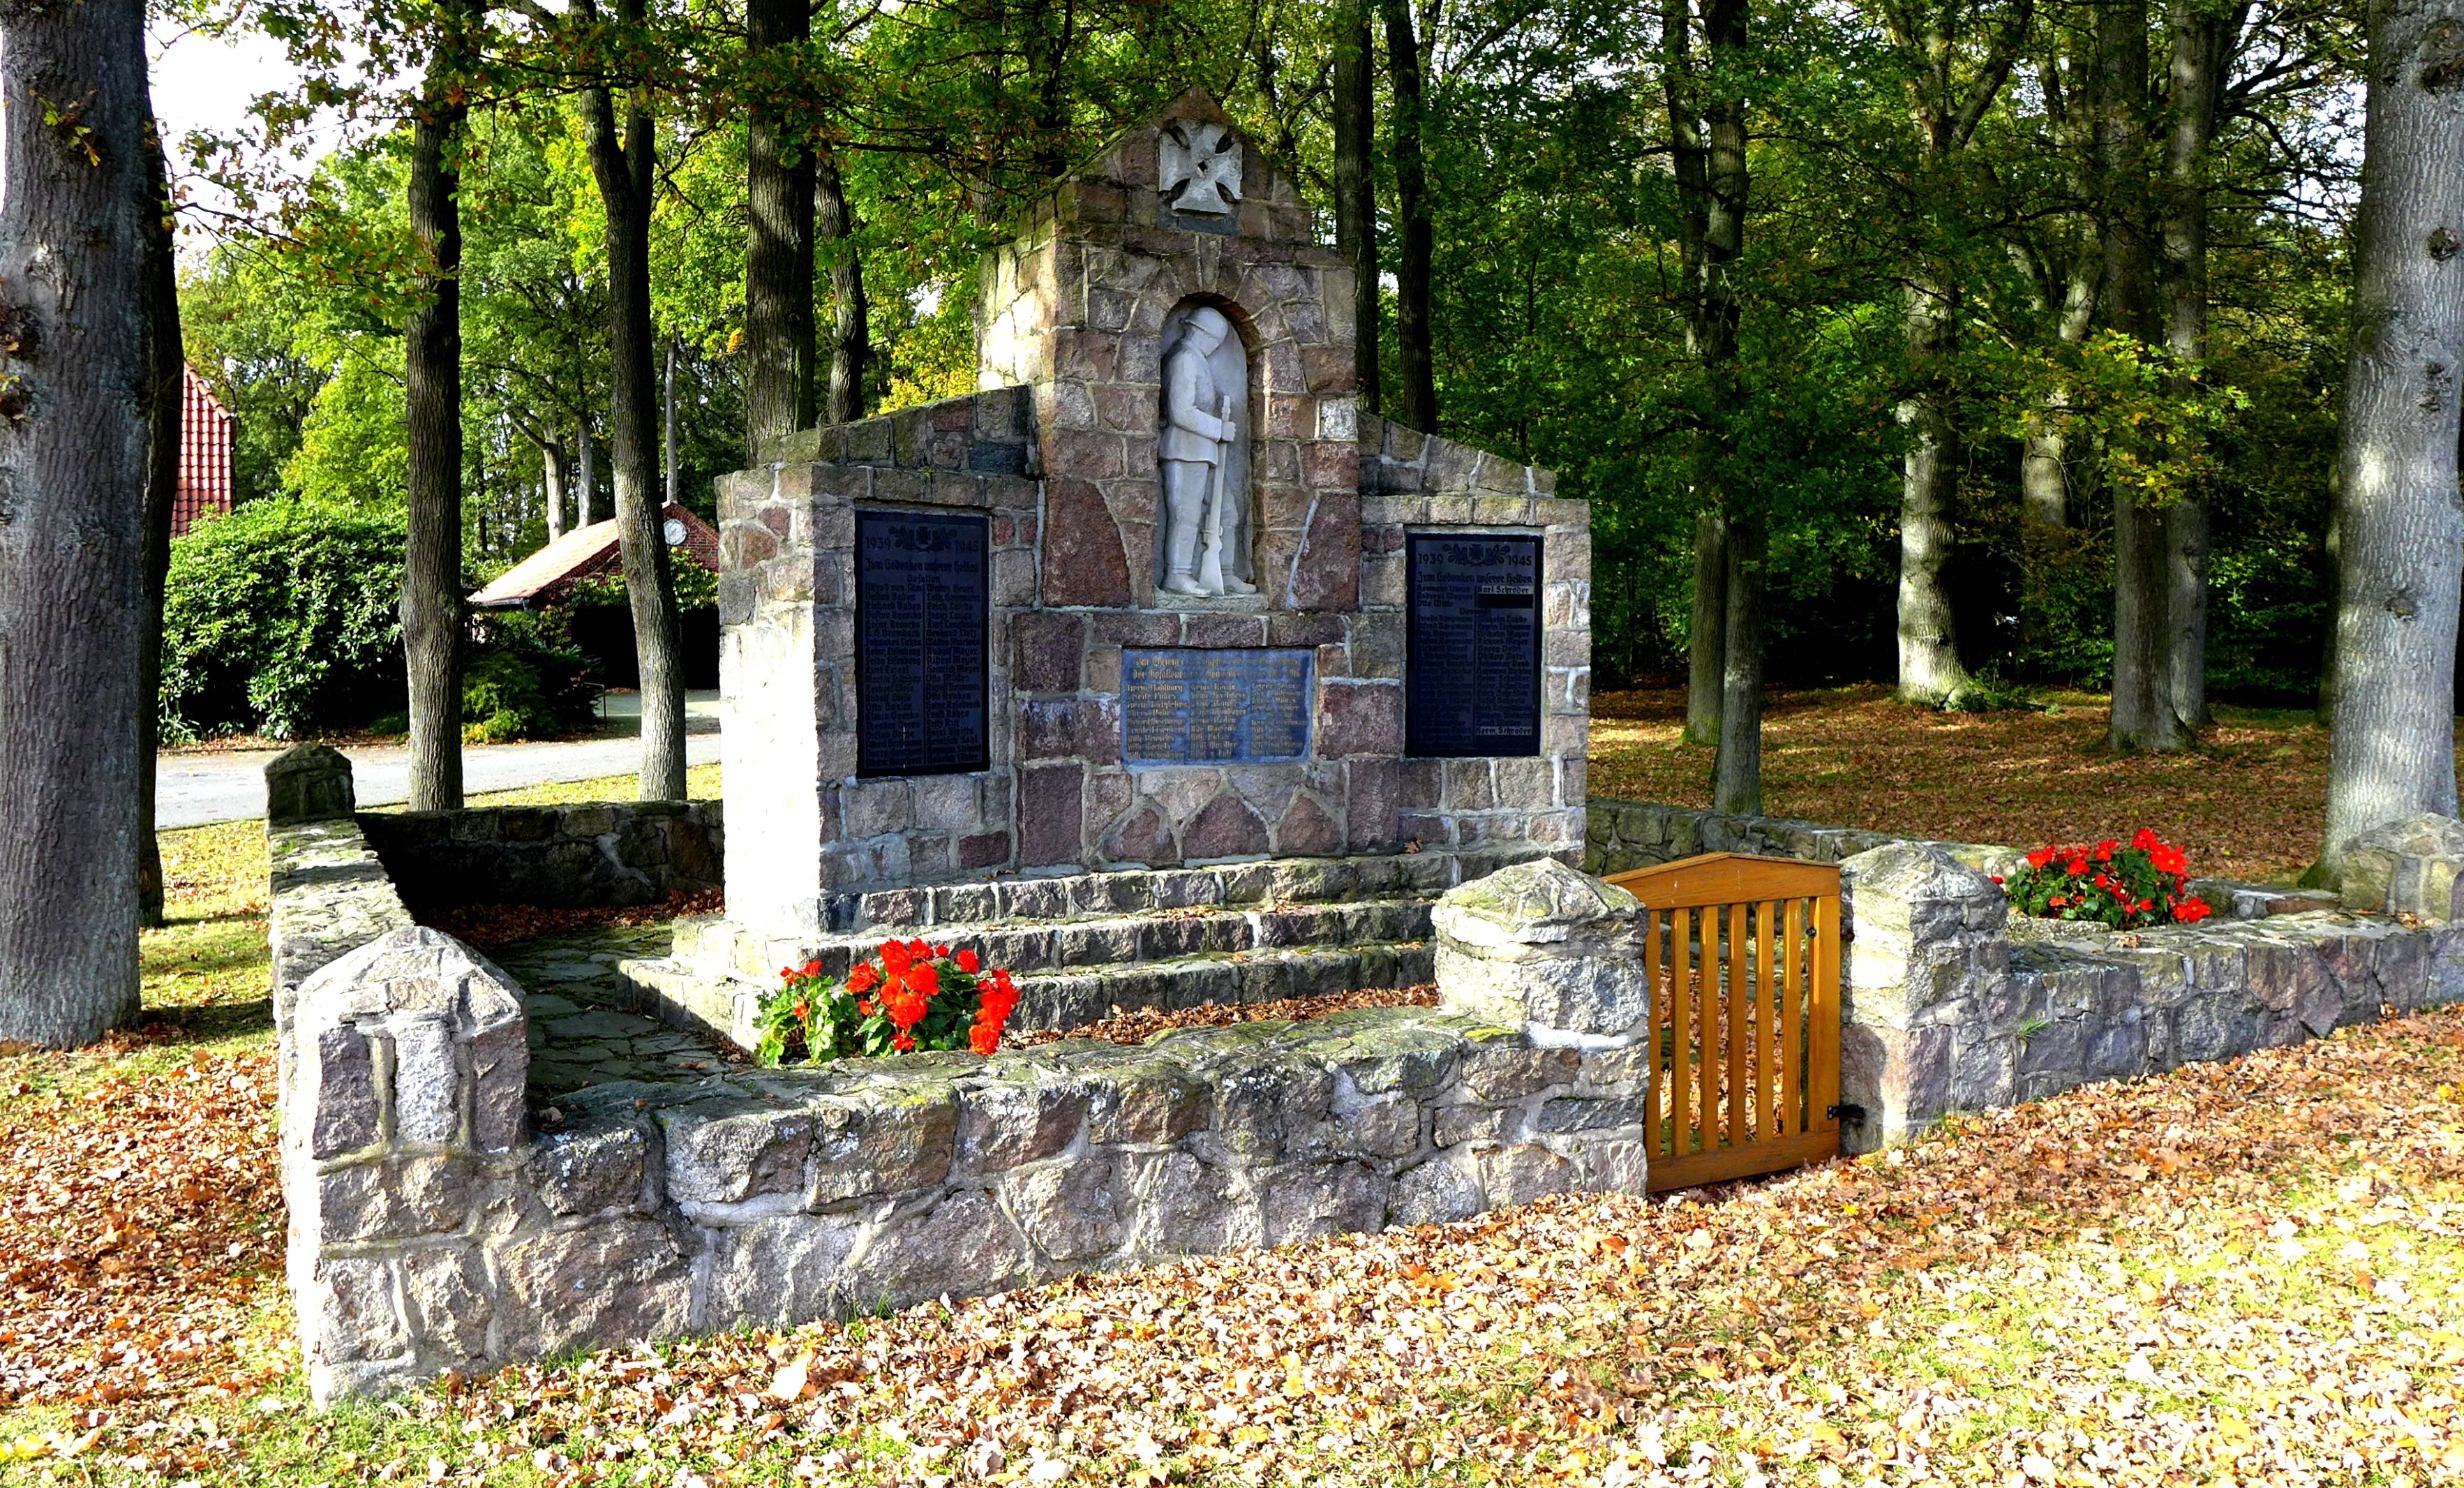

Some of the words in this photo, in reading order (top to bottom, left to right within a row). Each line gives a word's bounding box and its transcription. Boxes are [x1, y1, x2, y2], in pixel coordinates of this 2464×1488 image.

[865, 536, 891, 551] 1939
[955, 539, 979, 553] 1945
[1417, 553, 1444, 565] 1939
[1507, 556, 1532, 566] 1945
[865, 558, 883, 572] Zum
[884, 558, 923, 572] Gedenken
[953, 560, 978, 574] Helden
[906, 574, 941, 584] Gefallen
[1417, 572, 1435, 583] Zum
[1436, 572, 1475, 583] Gedenken
[1506, 573, 1532, 586] Helden
[865, 703, 882, 712] Otto
